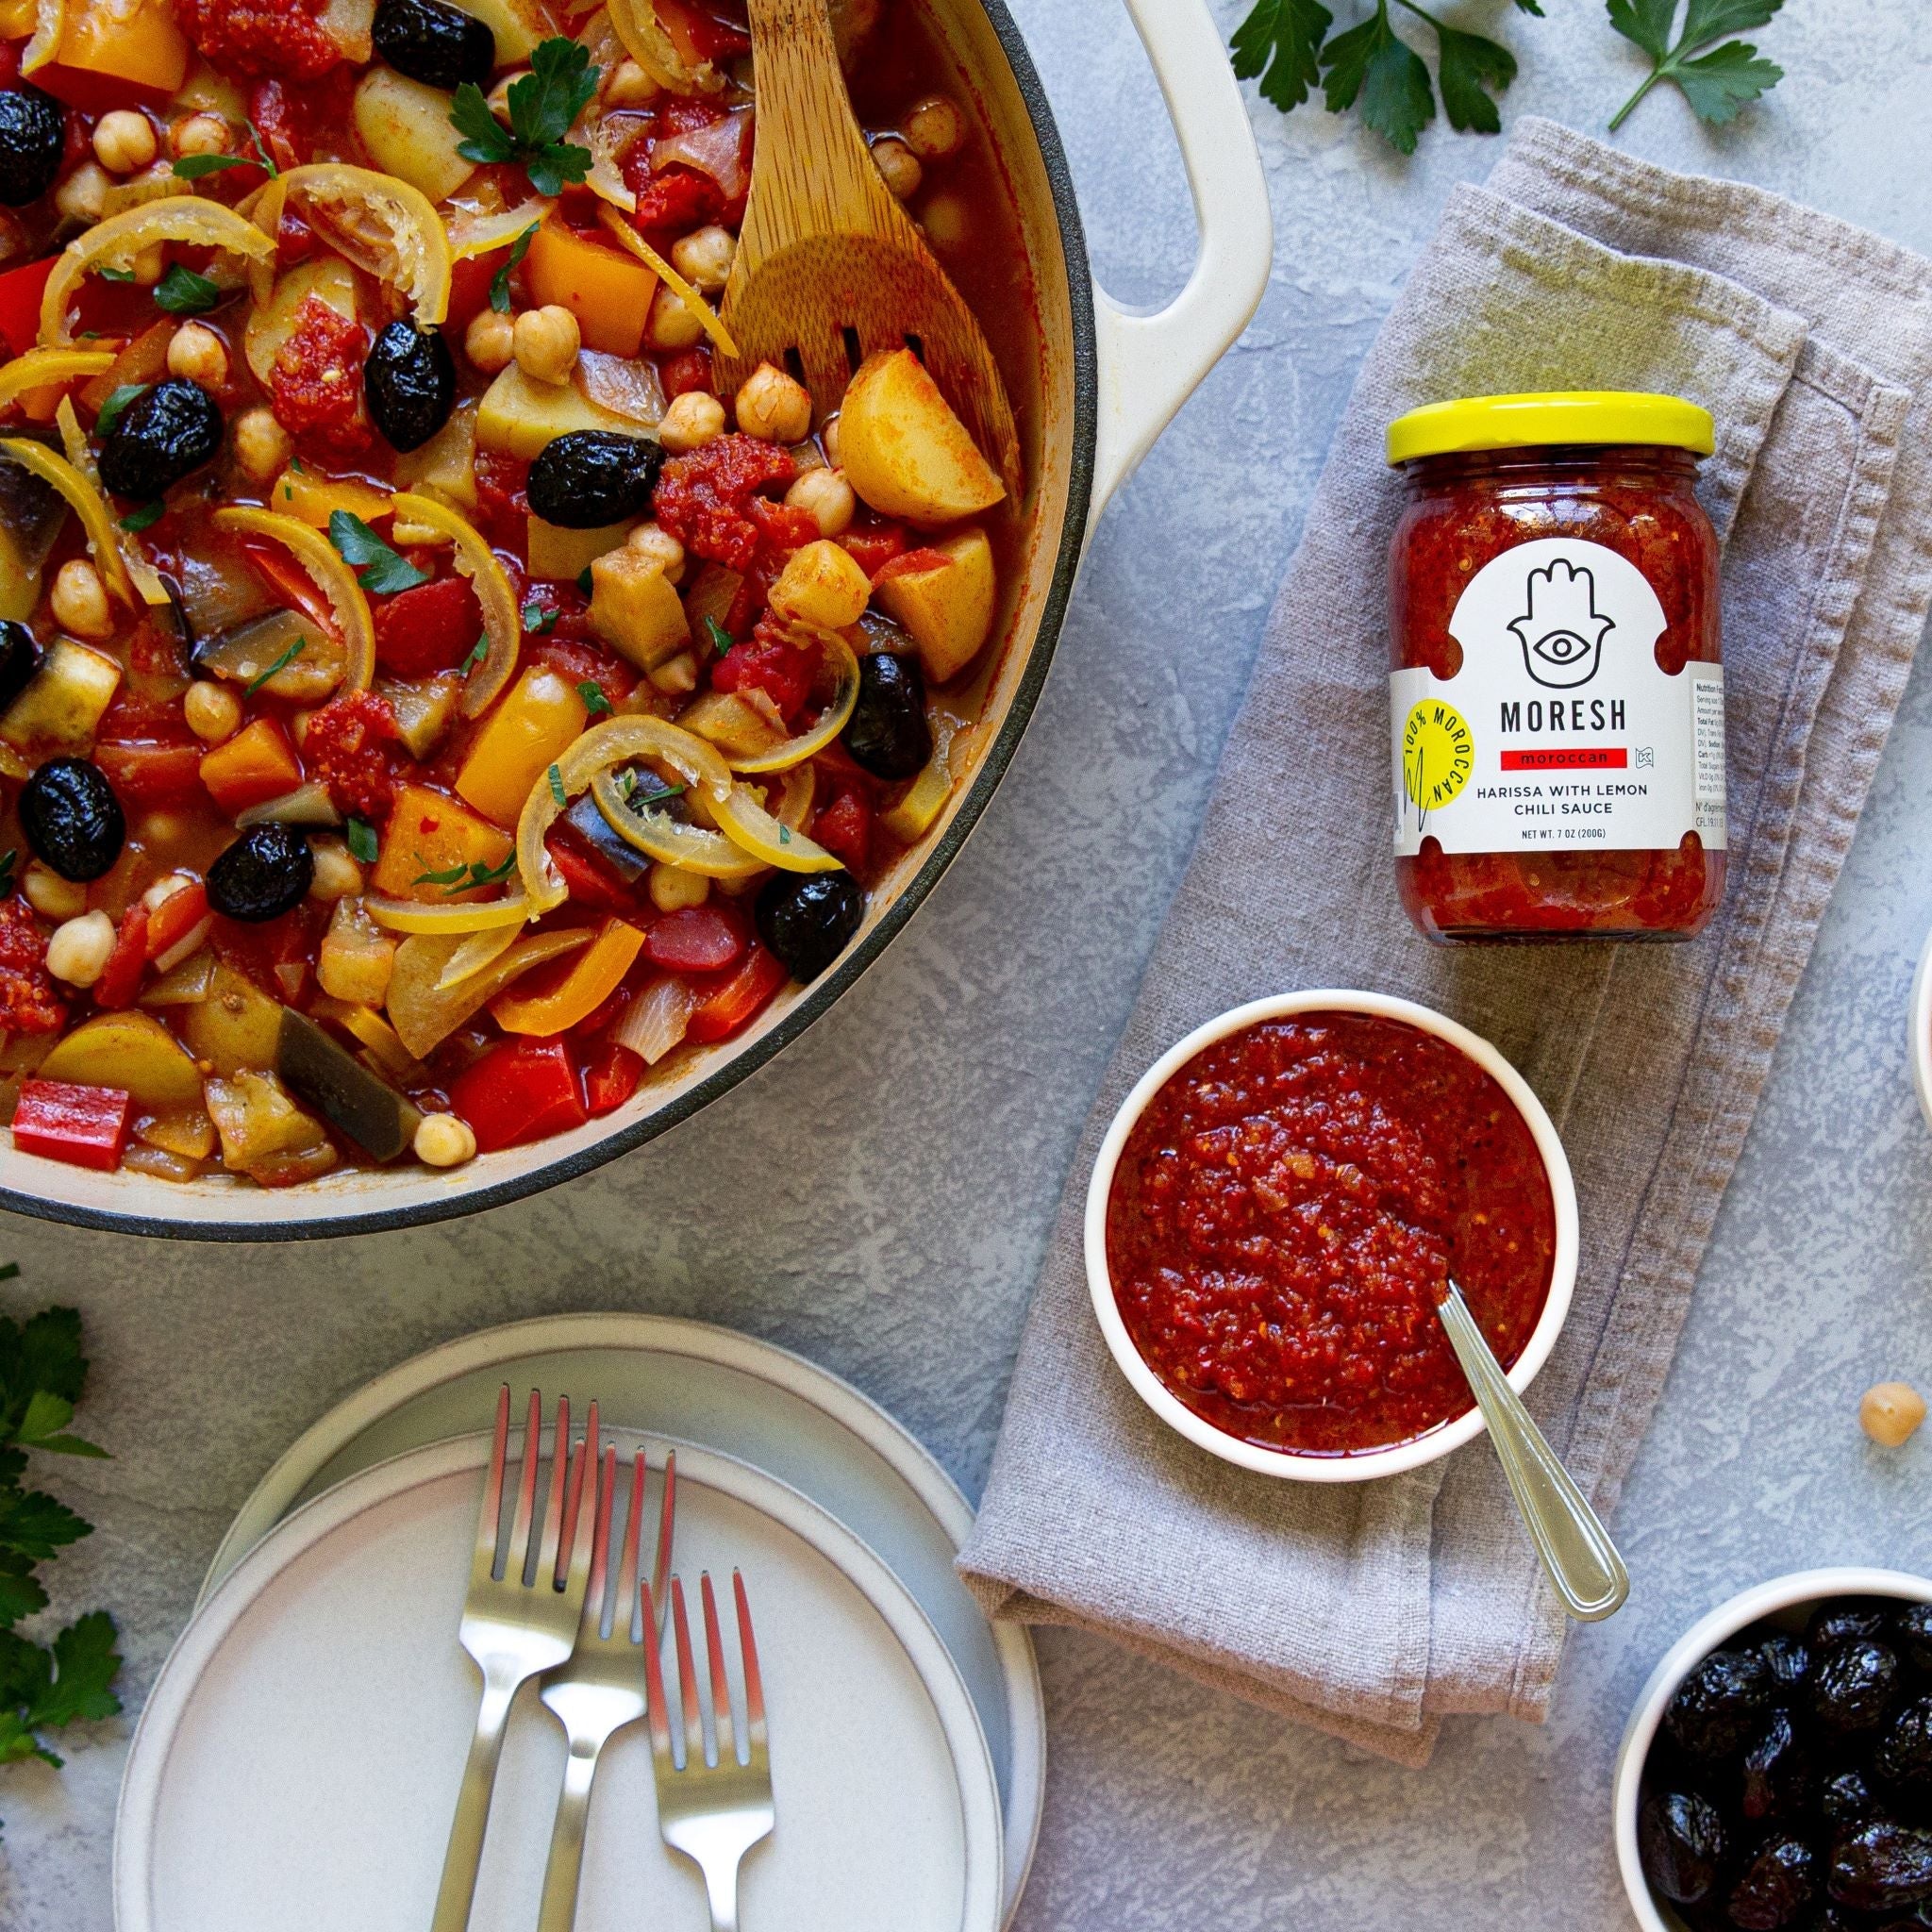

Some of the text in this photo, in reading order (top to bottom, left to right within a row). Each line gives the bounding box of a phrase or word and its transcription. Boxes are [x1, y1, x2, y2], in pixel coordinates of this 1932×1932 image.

[1501, 699, 1625, 733] MORESH
[1697, 717, 1707, 725] Total
[1405, 707, 1471, 802] 100% MOROCCAN
[1521, 752, 1607, 765] moroccan
[1476, 784, 1648, 799] HARISSA WITH LEMON
[1514, 803, 1613, 815] CHILI SAUCE
[1522, 828, 1607, 840] NET WT. 7 OZ (200G)
